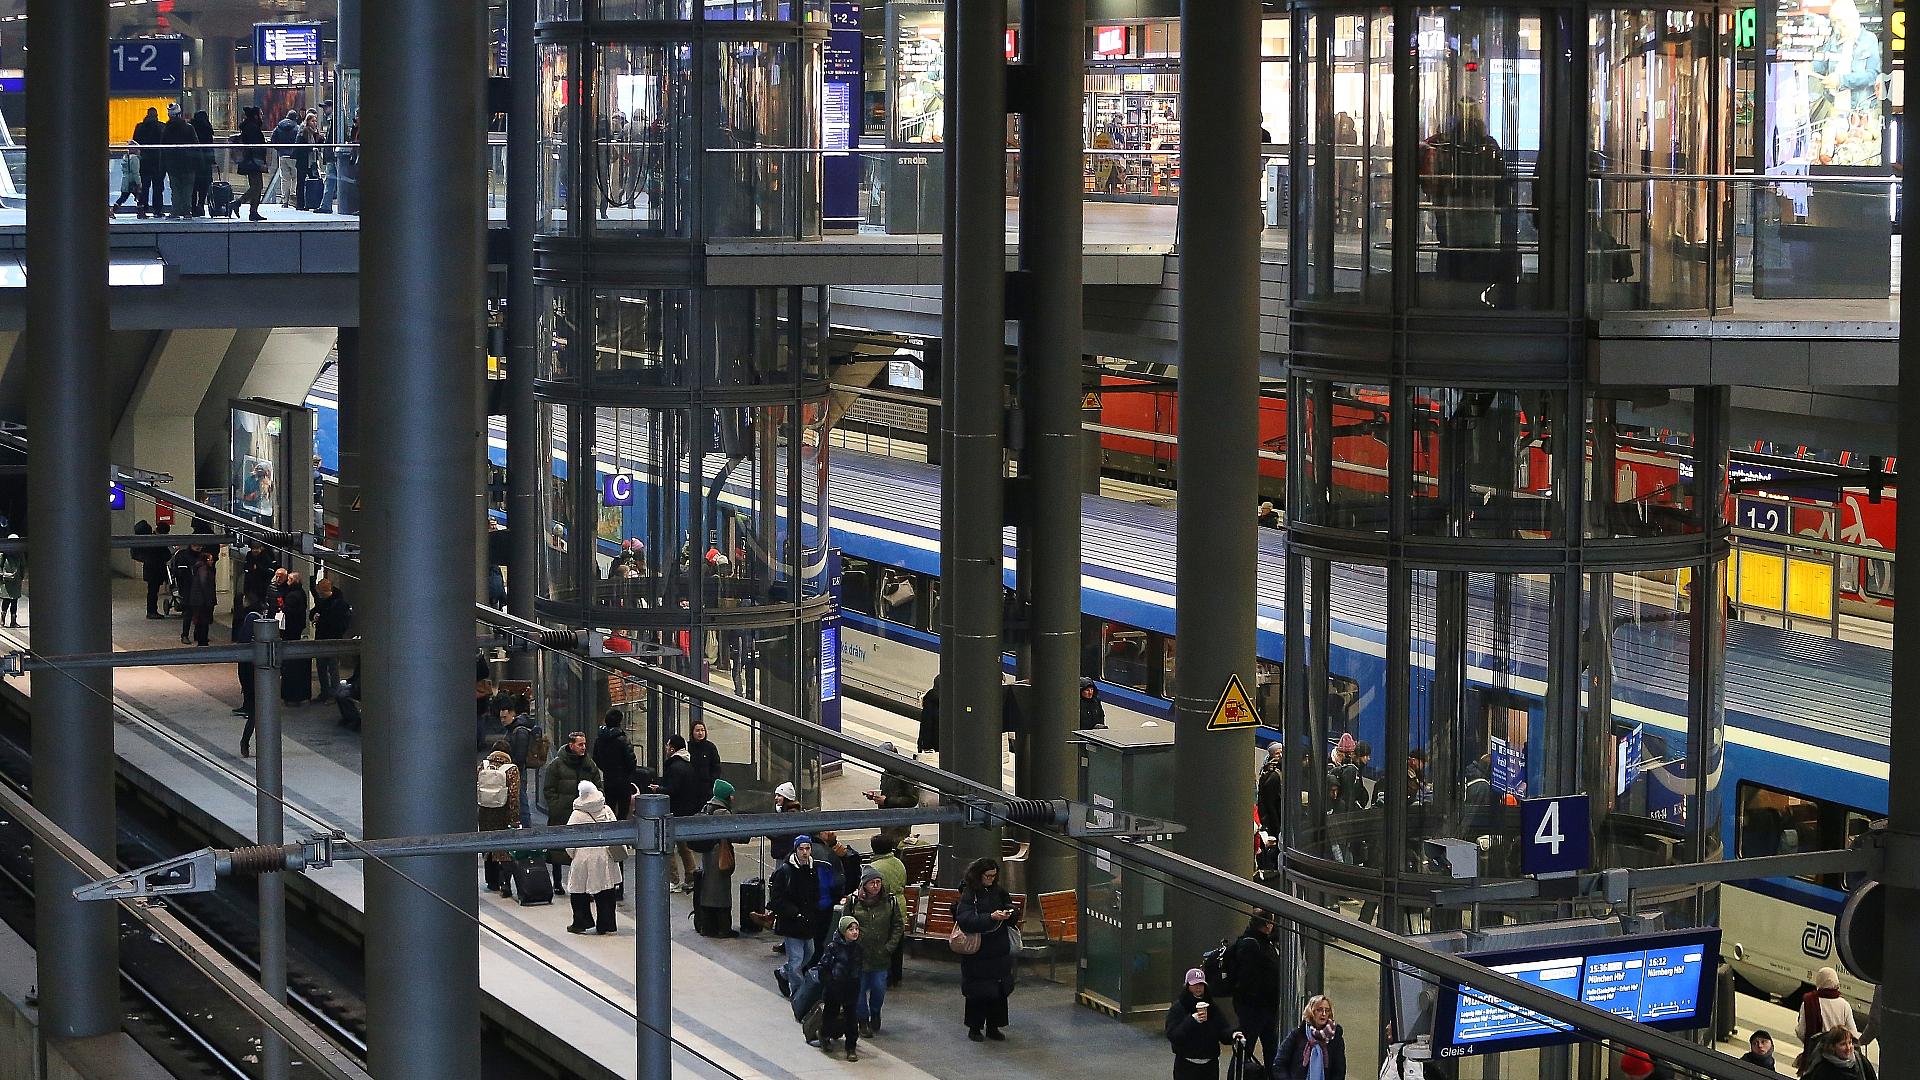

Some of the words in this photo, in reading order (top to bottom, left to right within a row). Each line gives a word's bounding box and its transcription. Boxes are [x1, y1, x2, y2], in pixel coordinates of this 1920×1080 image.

[834, 14, 848, 23] 1-2
[113, 45, 157, 71] 1-2
[898, 156, 928, 164] STRÖER
[613, 475, 630, 499] C
[1747, 508, 1779, 531] 1-2
[1534, 802, 1564, 854] 4
[1648, 957, 1666, 966] 16:12
[1648, 968, 1673, 977] Nürnberg
[1674, 966, 1684, 974] Hbf
[1588, 974, 1613, 983] München
[1614, 972, 1626, 980] Hbf
[1440, 1047, 1465, 1057] Gleis
[1467, 1045, 1474, 1054] 4
